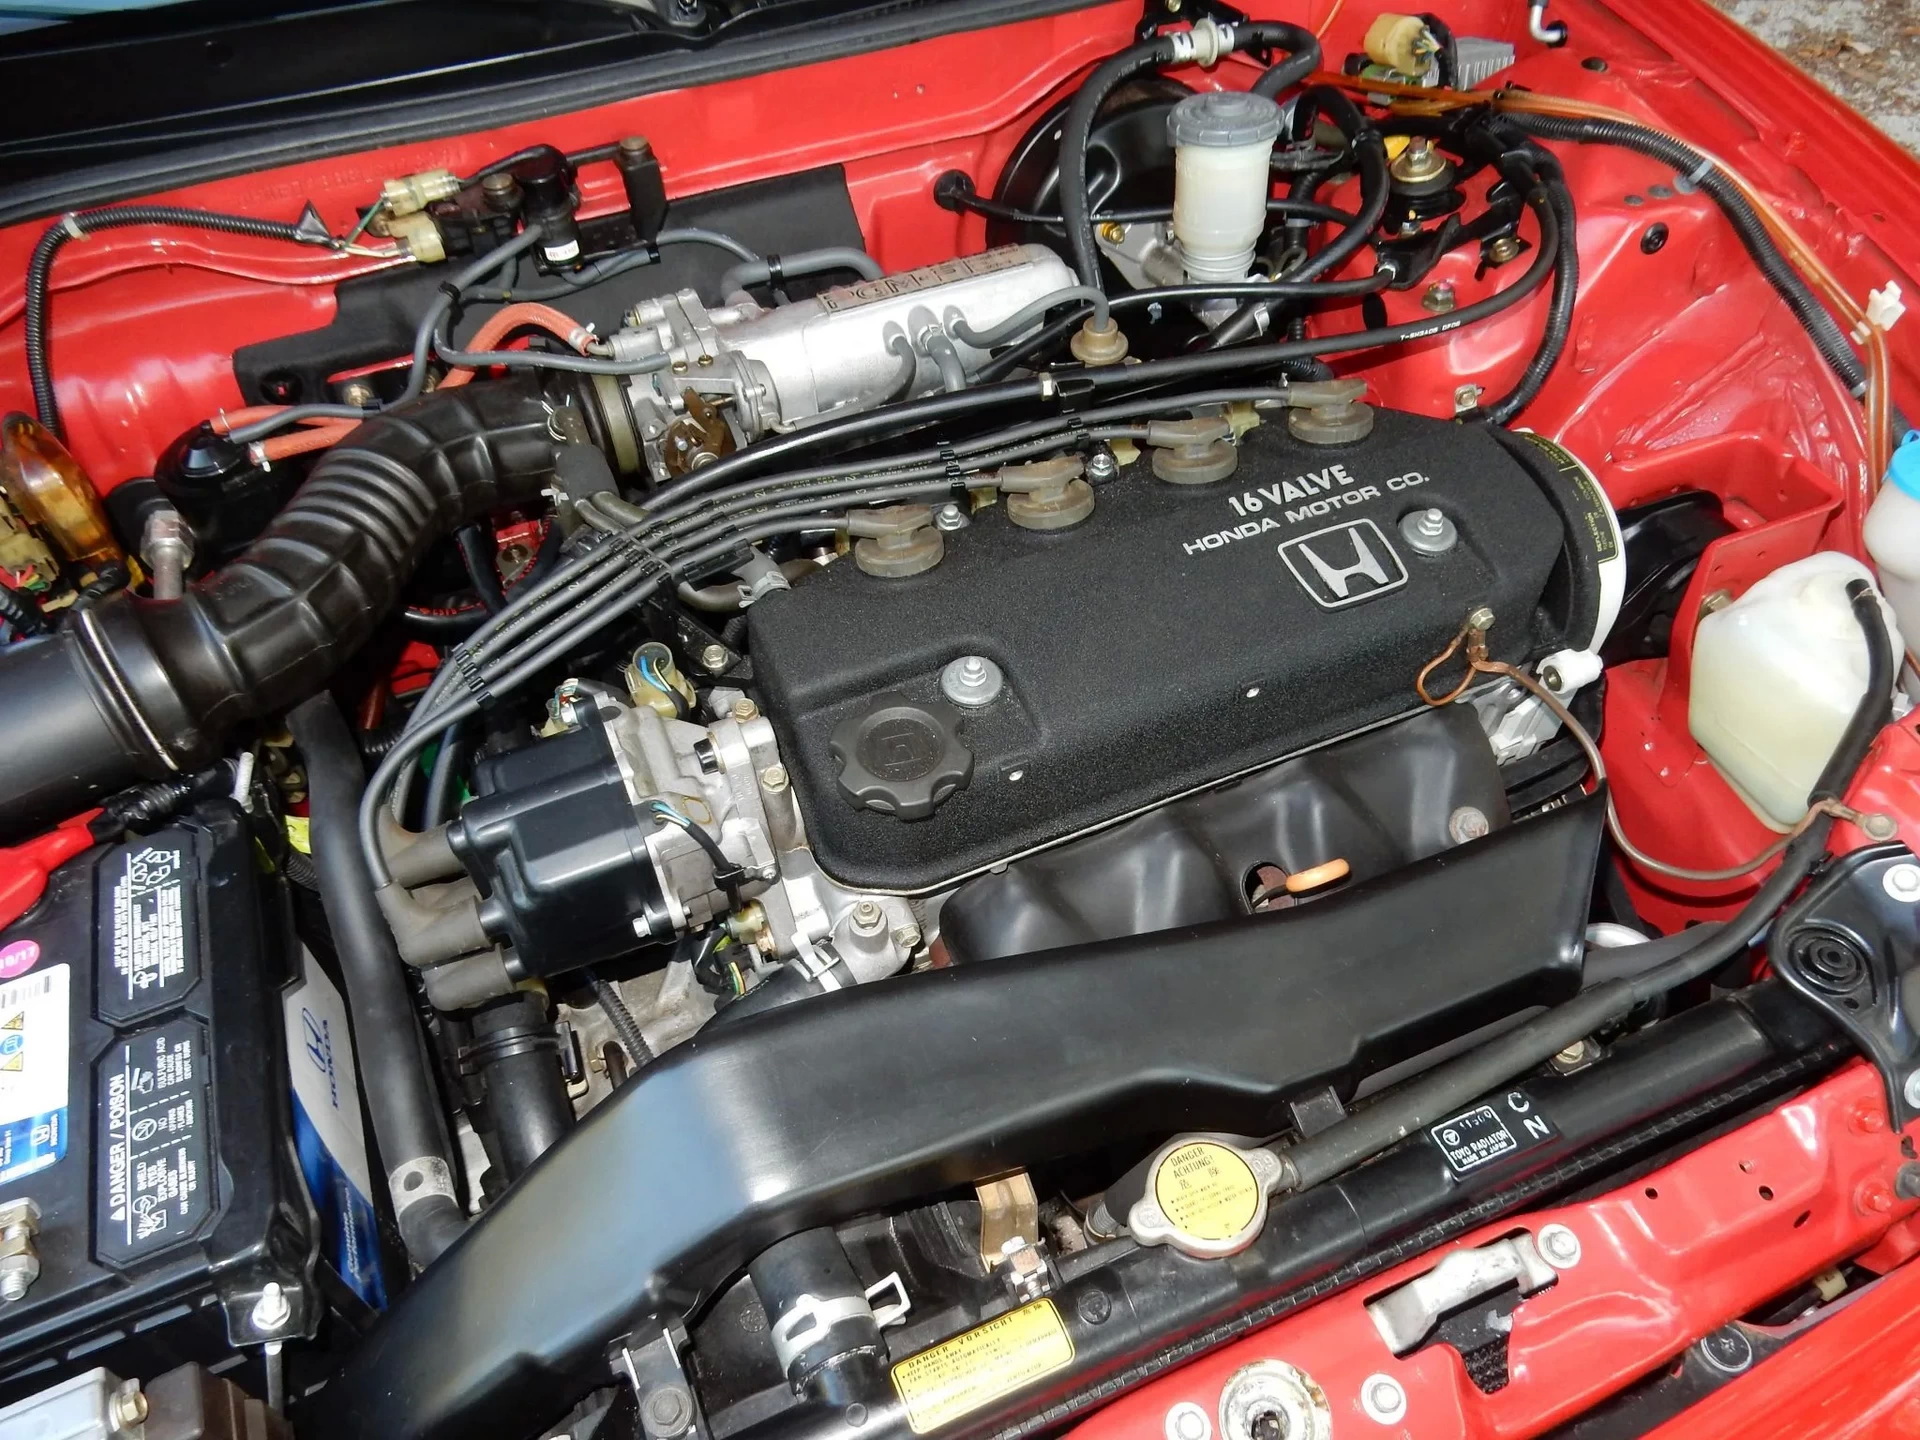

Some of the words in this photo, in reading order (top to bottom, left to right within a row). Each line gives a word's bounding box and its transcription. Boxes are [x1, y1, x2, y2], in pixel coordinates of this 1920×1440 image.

[1228, 492, 1264, 517] 16
[1257, 464, 1355, 506] VALVE
[1182, 517, 1281, 556] HONDA
[1285, 485, 1381, 524] MOTOR
[1386, 472, 1430, 492] CO.
[156, 1037, 166, 1053] ACID
[156, 1054, 167, 1089] SULFURIC
[322, 1019, 339, 1109] HONDA
[109, 1073, 125, 1130] POISON
[1508, 1092, 1530, 1112] C
[157, 1117, 168, 1131] NO
[1523, 1115, 1550, 1139] N
[1170, 1147, 1205, 1167] DANGER
[1450, 1146, 1471, 1161] TOYO
[1470, 1130, 1508, 1151] RADIATOR
[1462, 1152, 1479, 1165] MADE
[1489, 1141, 1508, 1153] JAPAN
[109, 1141, 125, 1207] DANGER
[137, 1161, 147, 1191] SHIELD
[147, 1165, 157, 1188] EYES
[157, 1157, 168, 1202] EXPLOSIVE
[1173, 1155, 1215, 1178] ACHTUNG!
[167, 1169, 178, 1198] GASES
[343, 1212, 354, 1273] Genuine
[908, 1346, 949, 1369] DANGER
[958, 1316, 1013, 1345] VORSICHT
